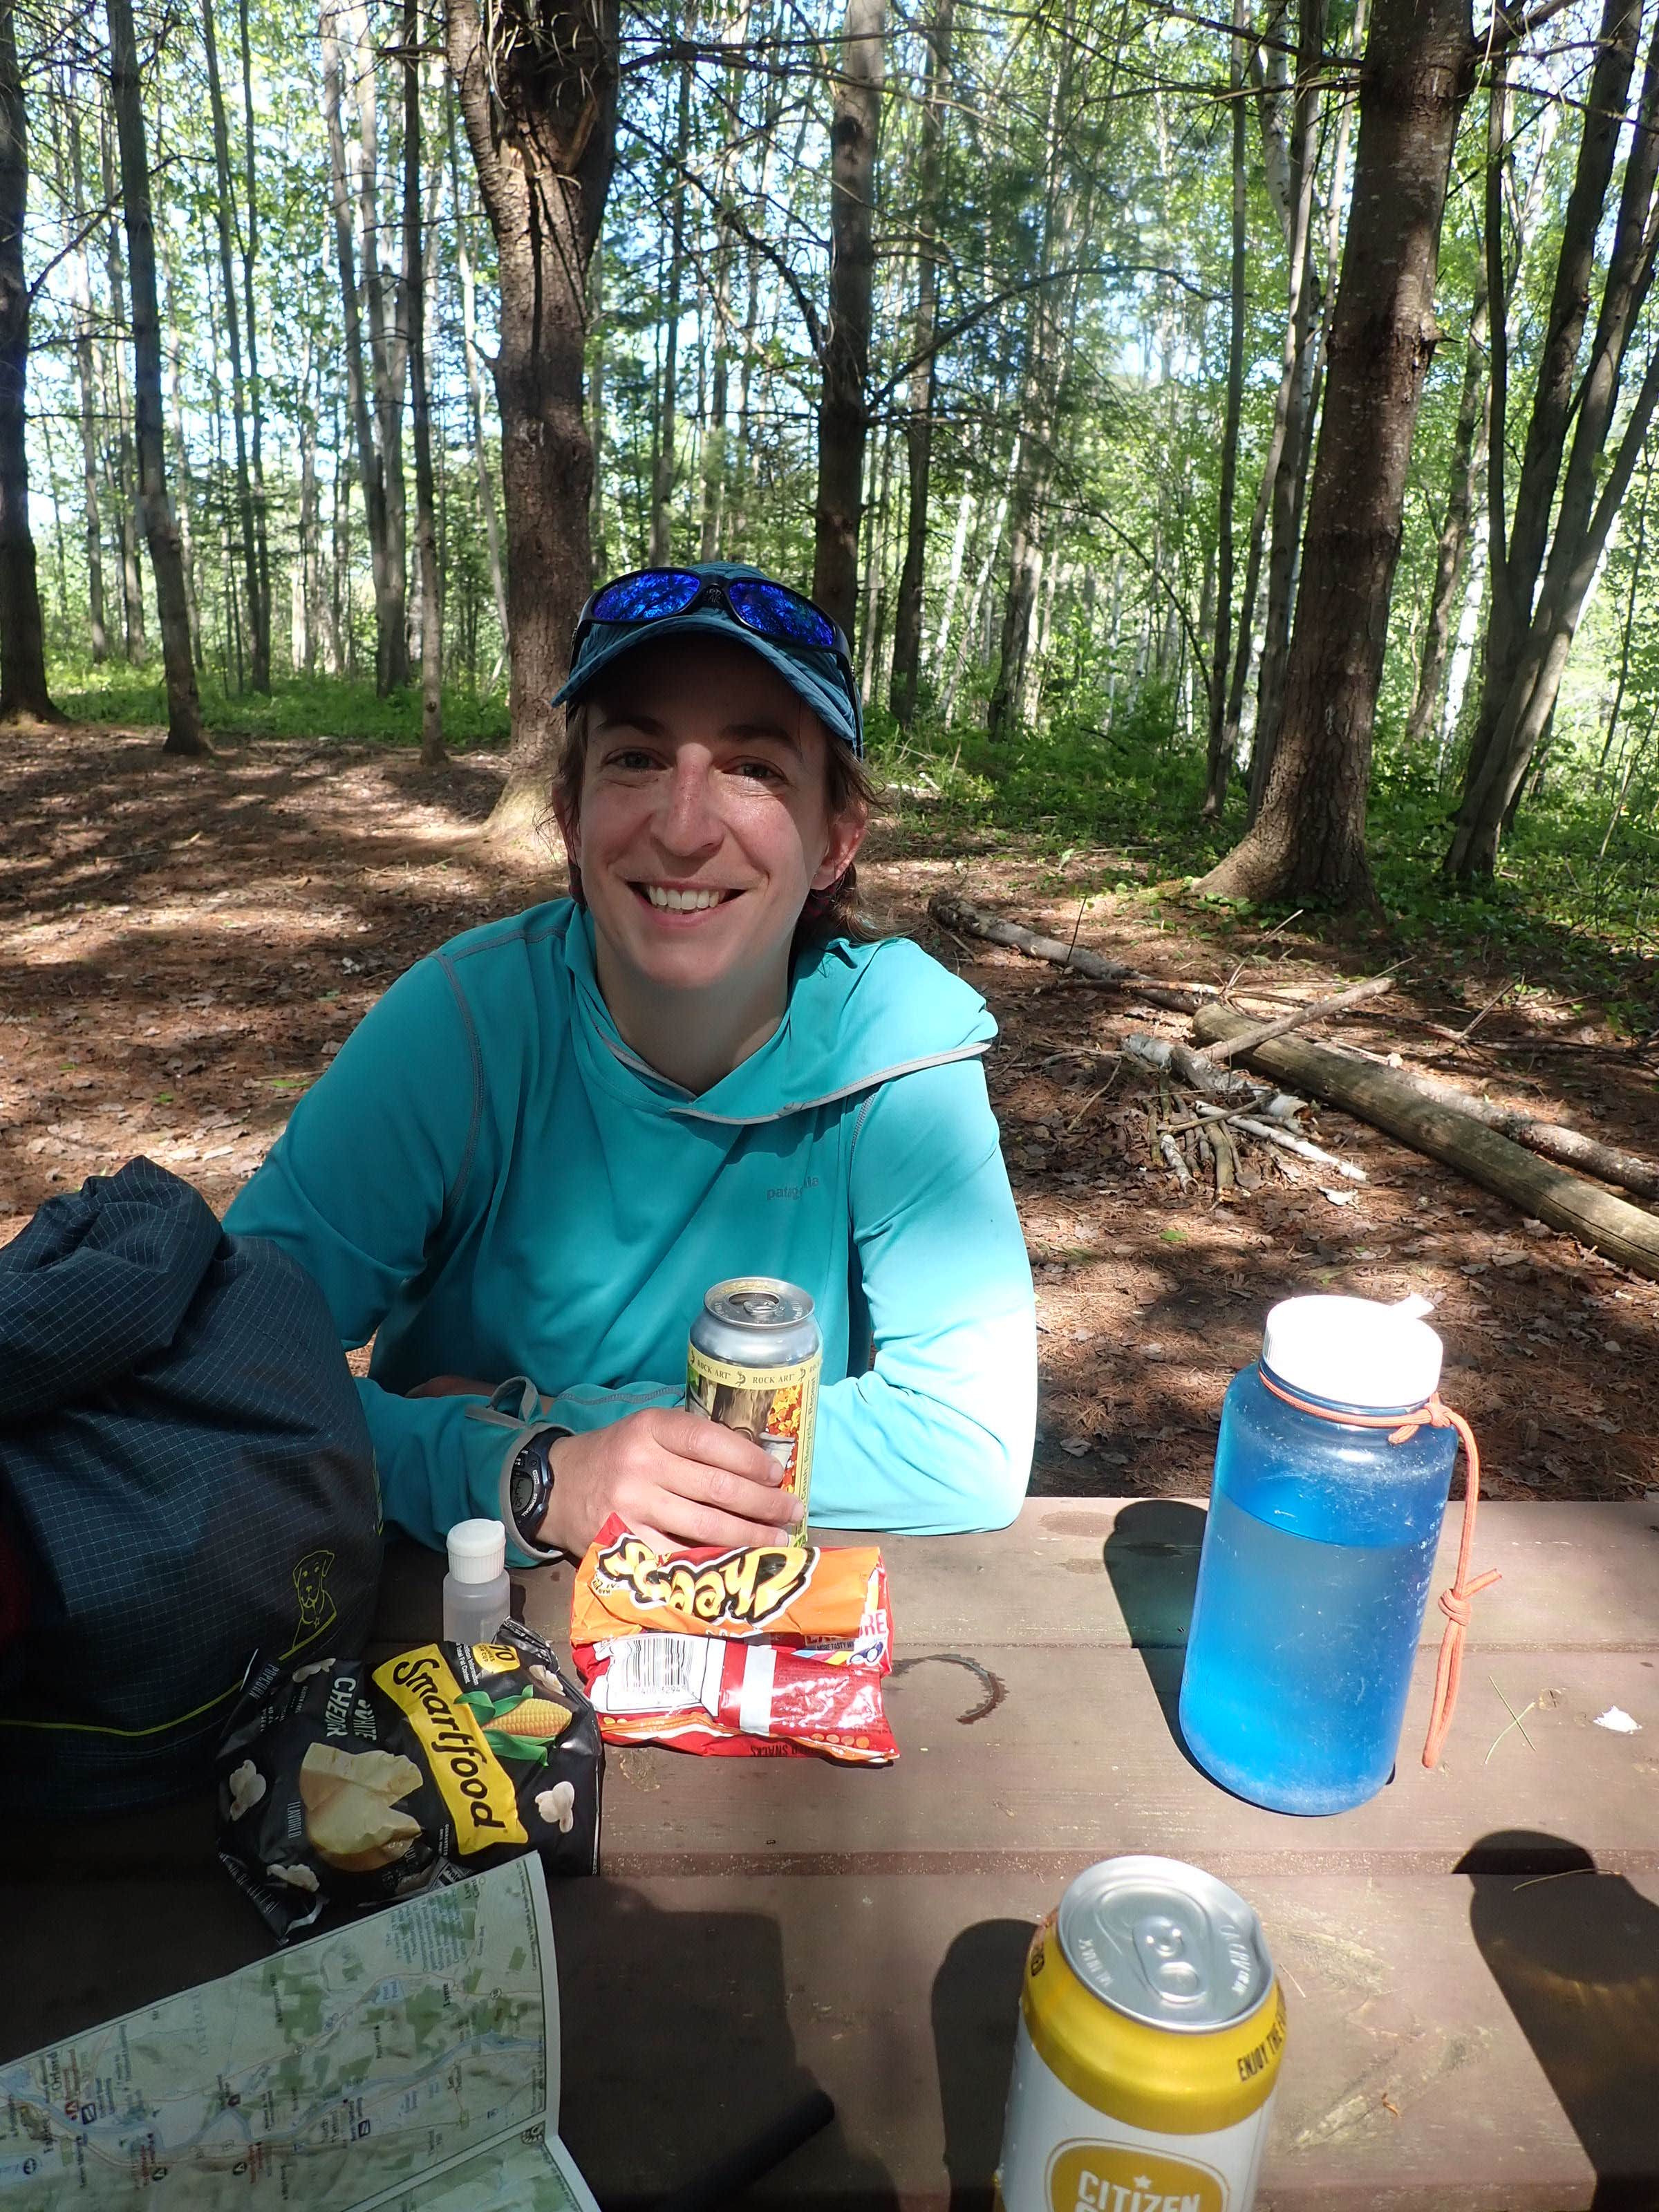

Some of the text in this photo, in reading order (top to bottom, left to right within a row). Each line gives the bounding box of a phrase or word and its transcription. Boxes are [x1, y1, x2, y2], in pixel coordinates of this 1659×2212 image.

[766, 1176, 818, 1201] patagia
[697, 1360, 712, 1373] ROCK
[600, 1541, 811, 1620] Cheeos
[859, 1612, 886, 1636] RE
[248, 1664, 281, 1703] POPCORN
[353, 1698, 377, 1741] WHITE
[392, 1658, 506, 1829] Smartfood
[287, 1801, 303, 1838] FLAVORED
[442, 1983, 451, 2007] Lyme
[1237, 2042, 1268, 2081] ENJOY
[1077, 2169, 1201, 2212] CITIZEN
